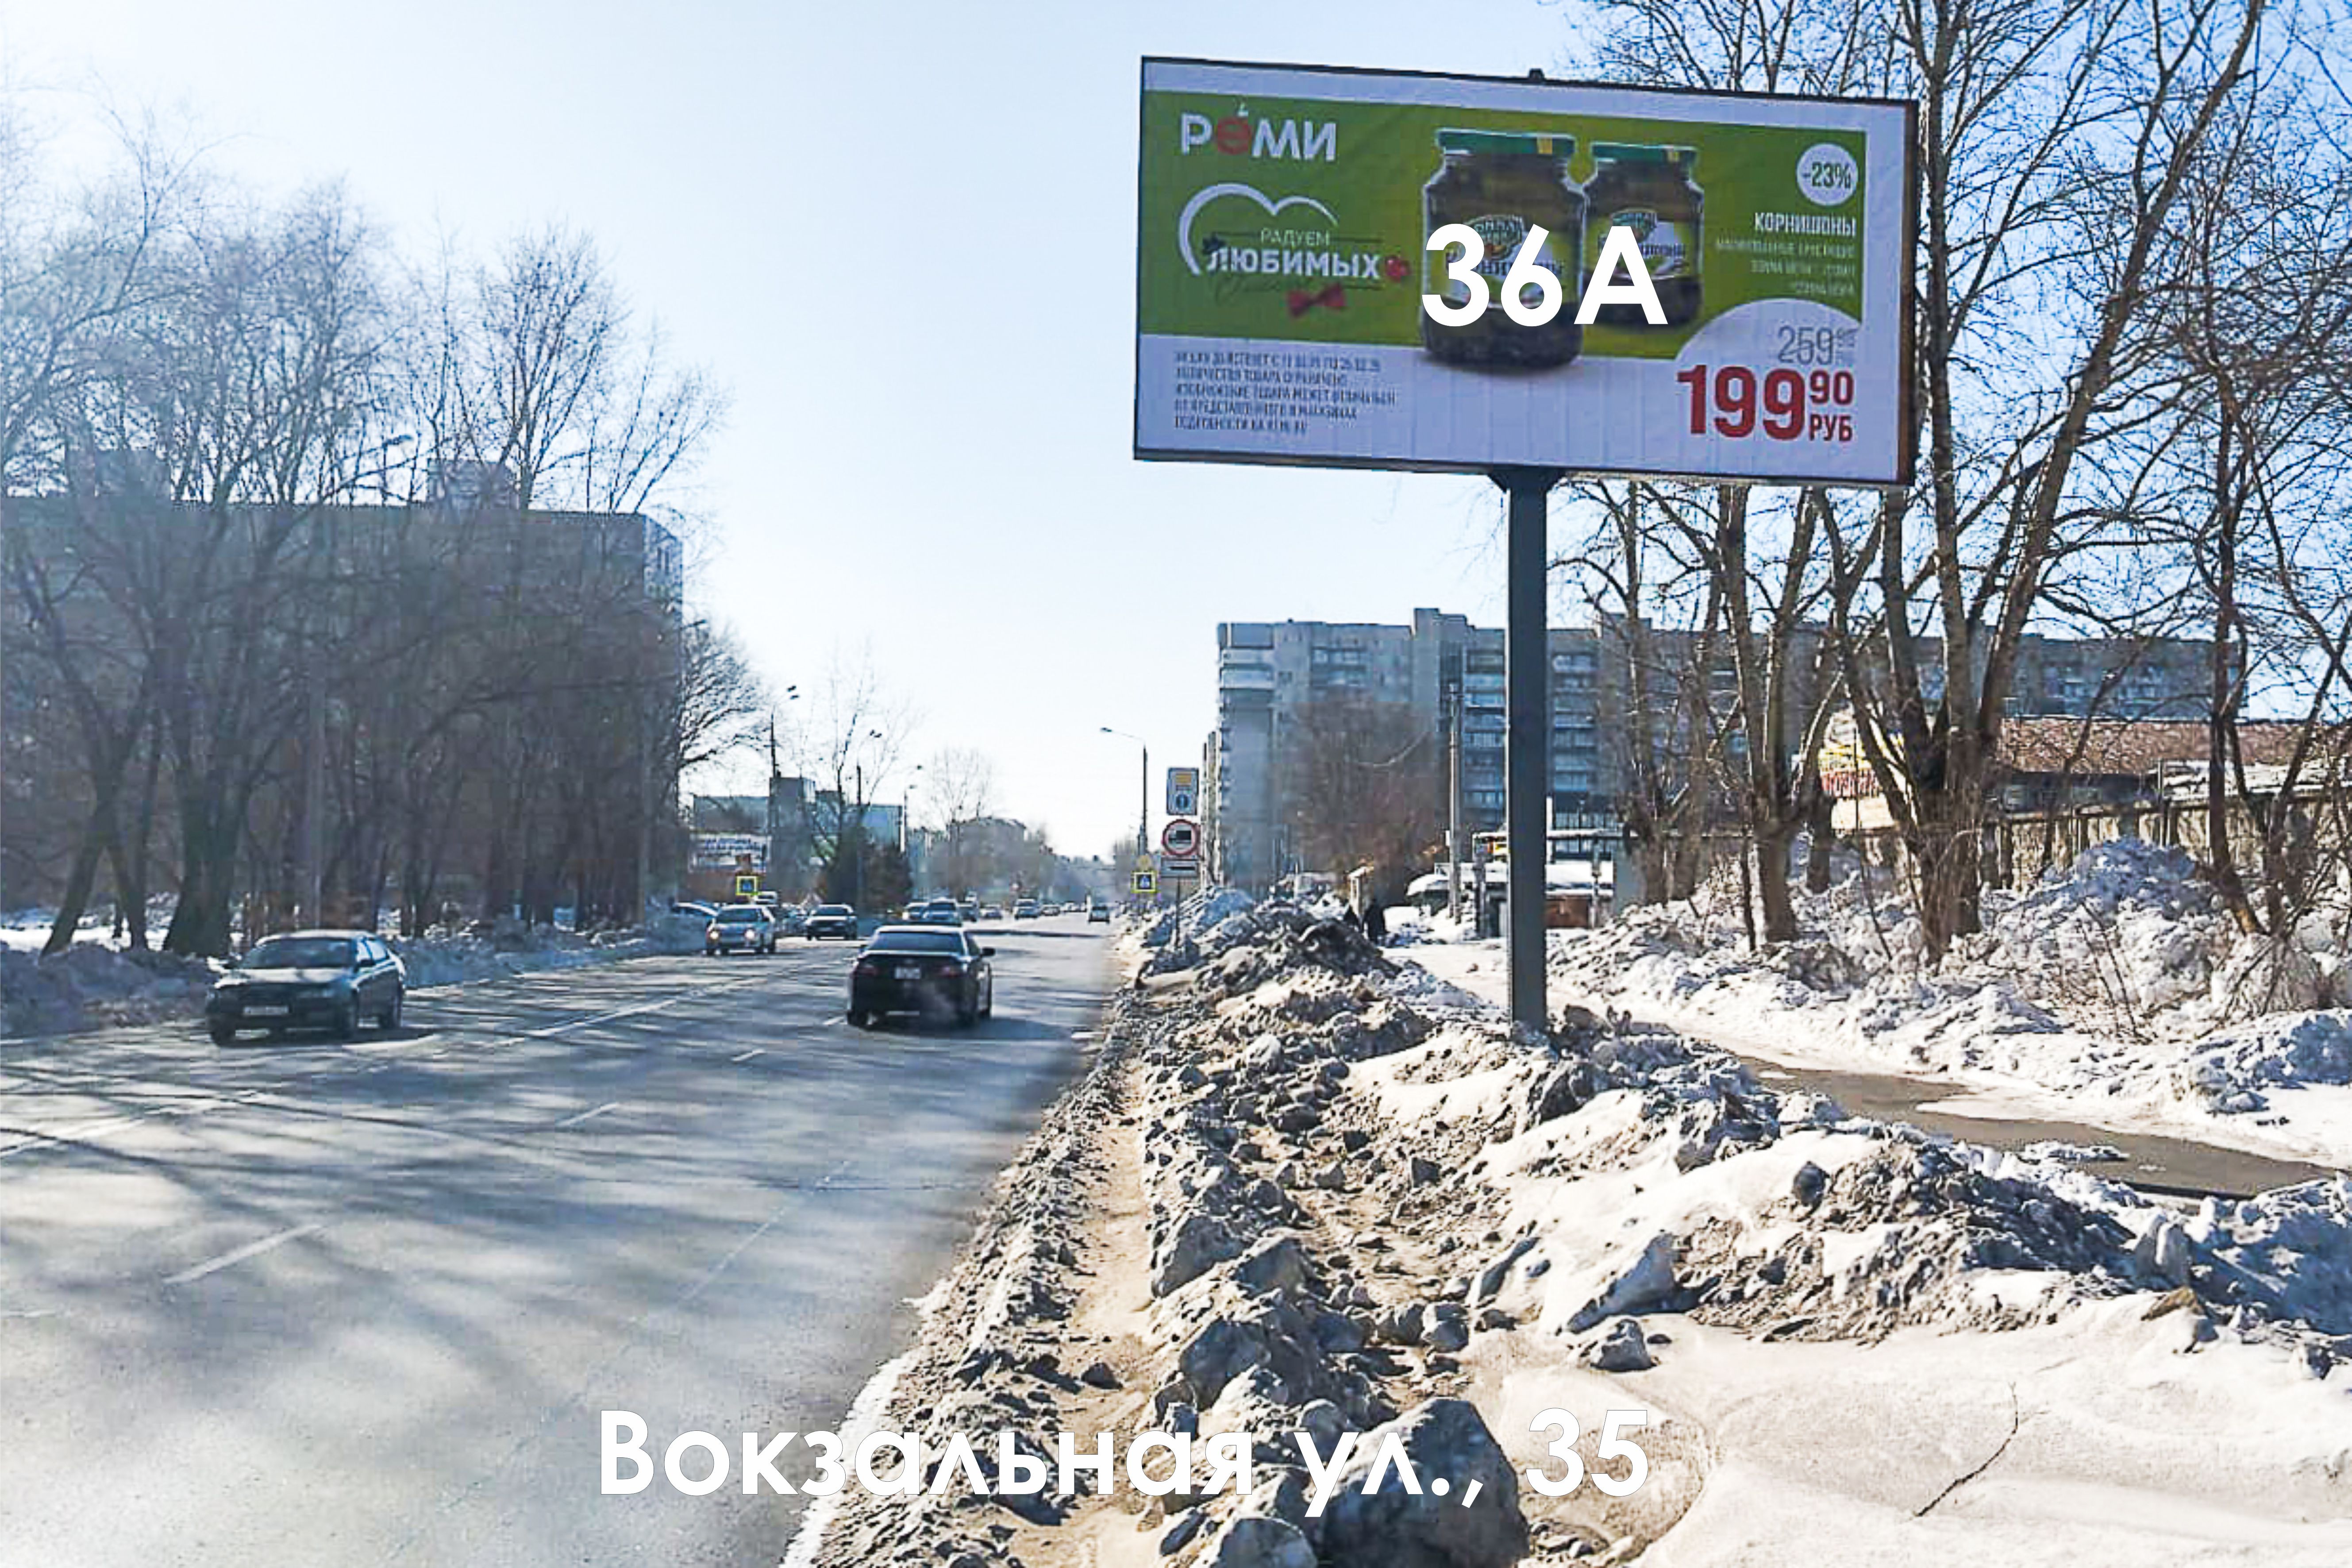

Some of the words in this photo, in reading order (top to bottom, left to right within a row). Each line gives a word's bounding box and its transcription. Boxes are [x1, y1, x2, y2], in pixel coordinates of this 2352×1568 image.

[1802, 162, 1852, 189] -23%
[1260, 227, 1330, 249] РАДУЕМ
[1755, 212, 1856, 238] КОРНИШОНЫ
[1207, 247, 1381, 280] ЛЮБИМЫХ
[1677, 364, 1805, 439] 199
[1809, 370, 1854, 405] 90
[1810, 414, 1853, 441] РУБ
